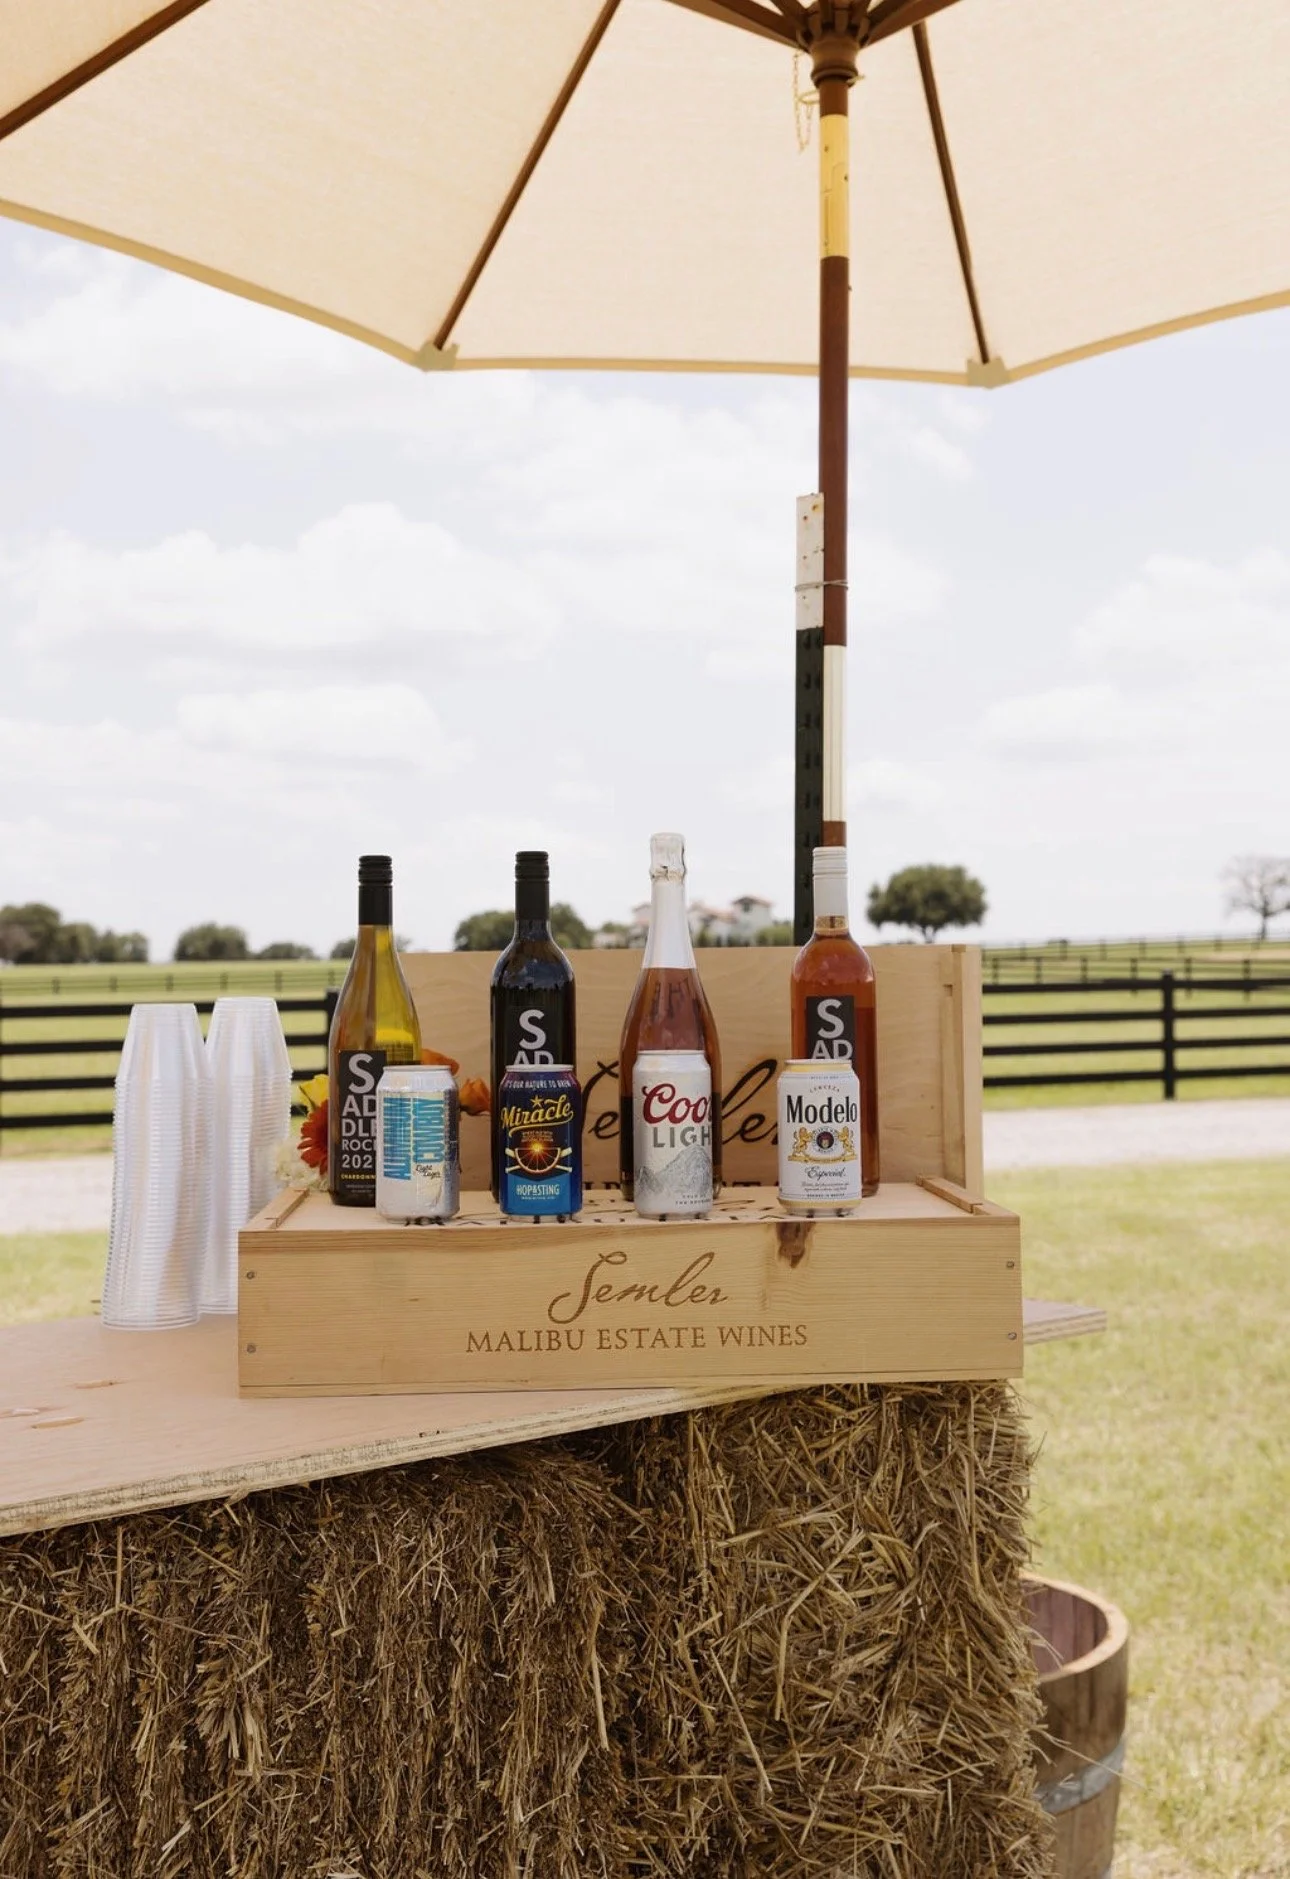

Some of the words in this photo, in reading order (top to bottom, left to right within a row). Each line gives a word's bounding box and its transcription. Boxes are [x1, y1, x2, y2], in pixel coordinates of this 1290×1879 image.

[519, 1009, 547, 1050] S
[817, 998, 845, 1039] S
[513, 1050, 554, 1065] AD
[811, 1039, 853, 1060] AD
[348, 1053, 375, 1094] S
[502, 1094, 574, 1131] Miracle
[786, 1094, 858, 1124] Modelo
[342, 1139, 377, 1151] ROC
[548, 1251, 729, 1324] Semler
[466, 1329, 585, 1353] MALIBU
[596, 1326, 706, 1350] ESTATE
[717, 1324, 808, 1347] WINES
